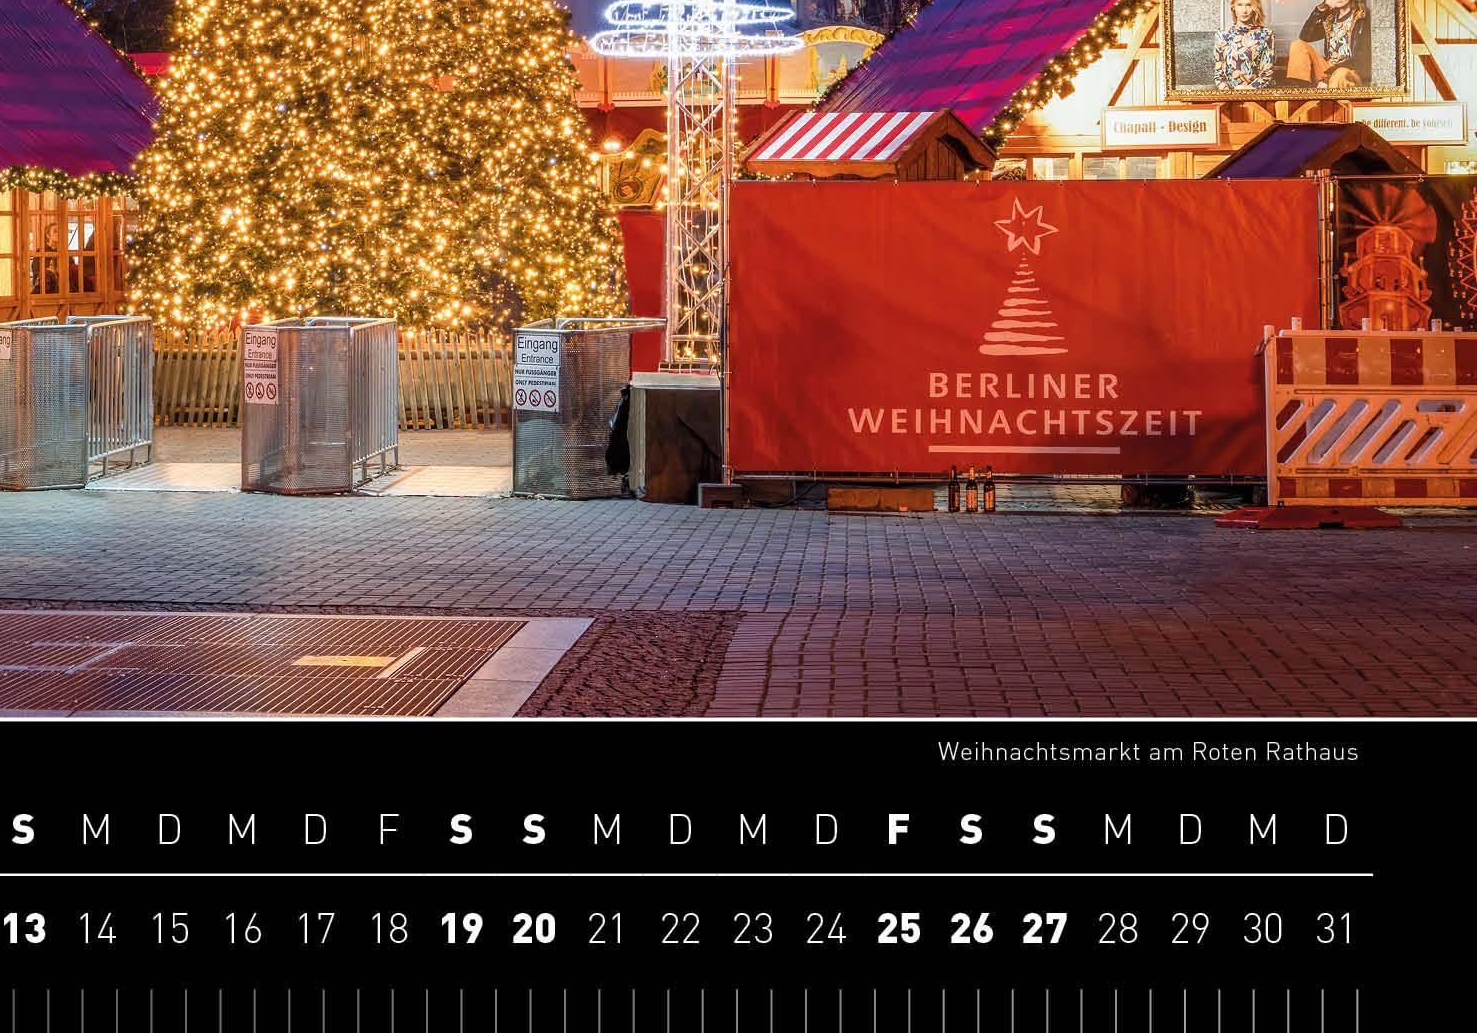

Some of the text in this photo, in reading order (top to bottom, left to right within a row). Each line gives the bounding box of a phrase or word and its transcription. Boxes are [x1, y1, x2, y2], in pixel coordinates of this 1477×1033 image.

[1168, 120, 1207, 133] Design
[1411, 118, 1421, 128] be
[245, 332, 277, 349] Eingang
[517, 336, 558, 354] Eingang
[247, 349, 273, 359] Entrance
[521, 353, 554, 364] Entrance
[928, 372, 1120, 399] BERLINER
[847, 408, 1204, 436] WEIHNACHTSZEIT
